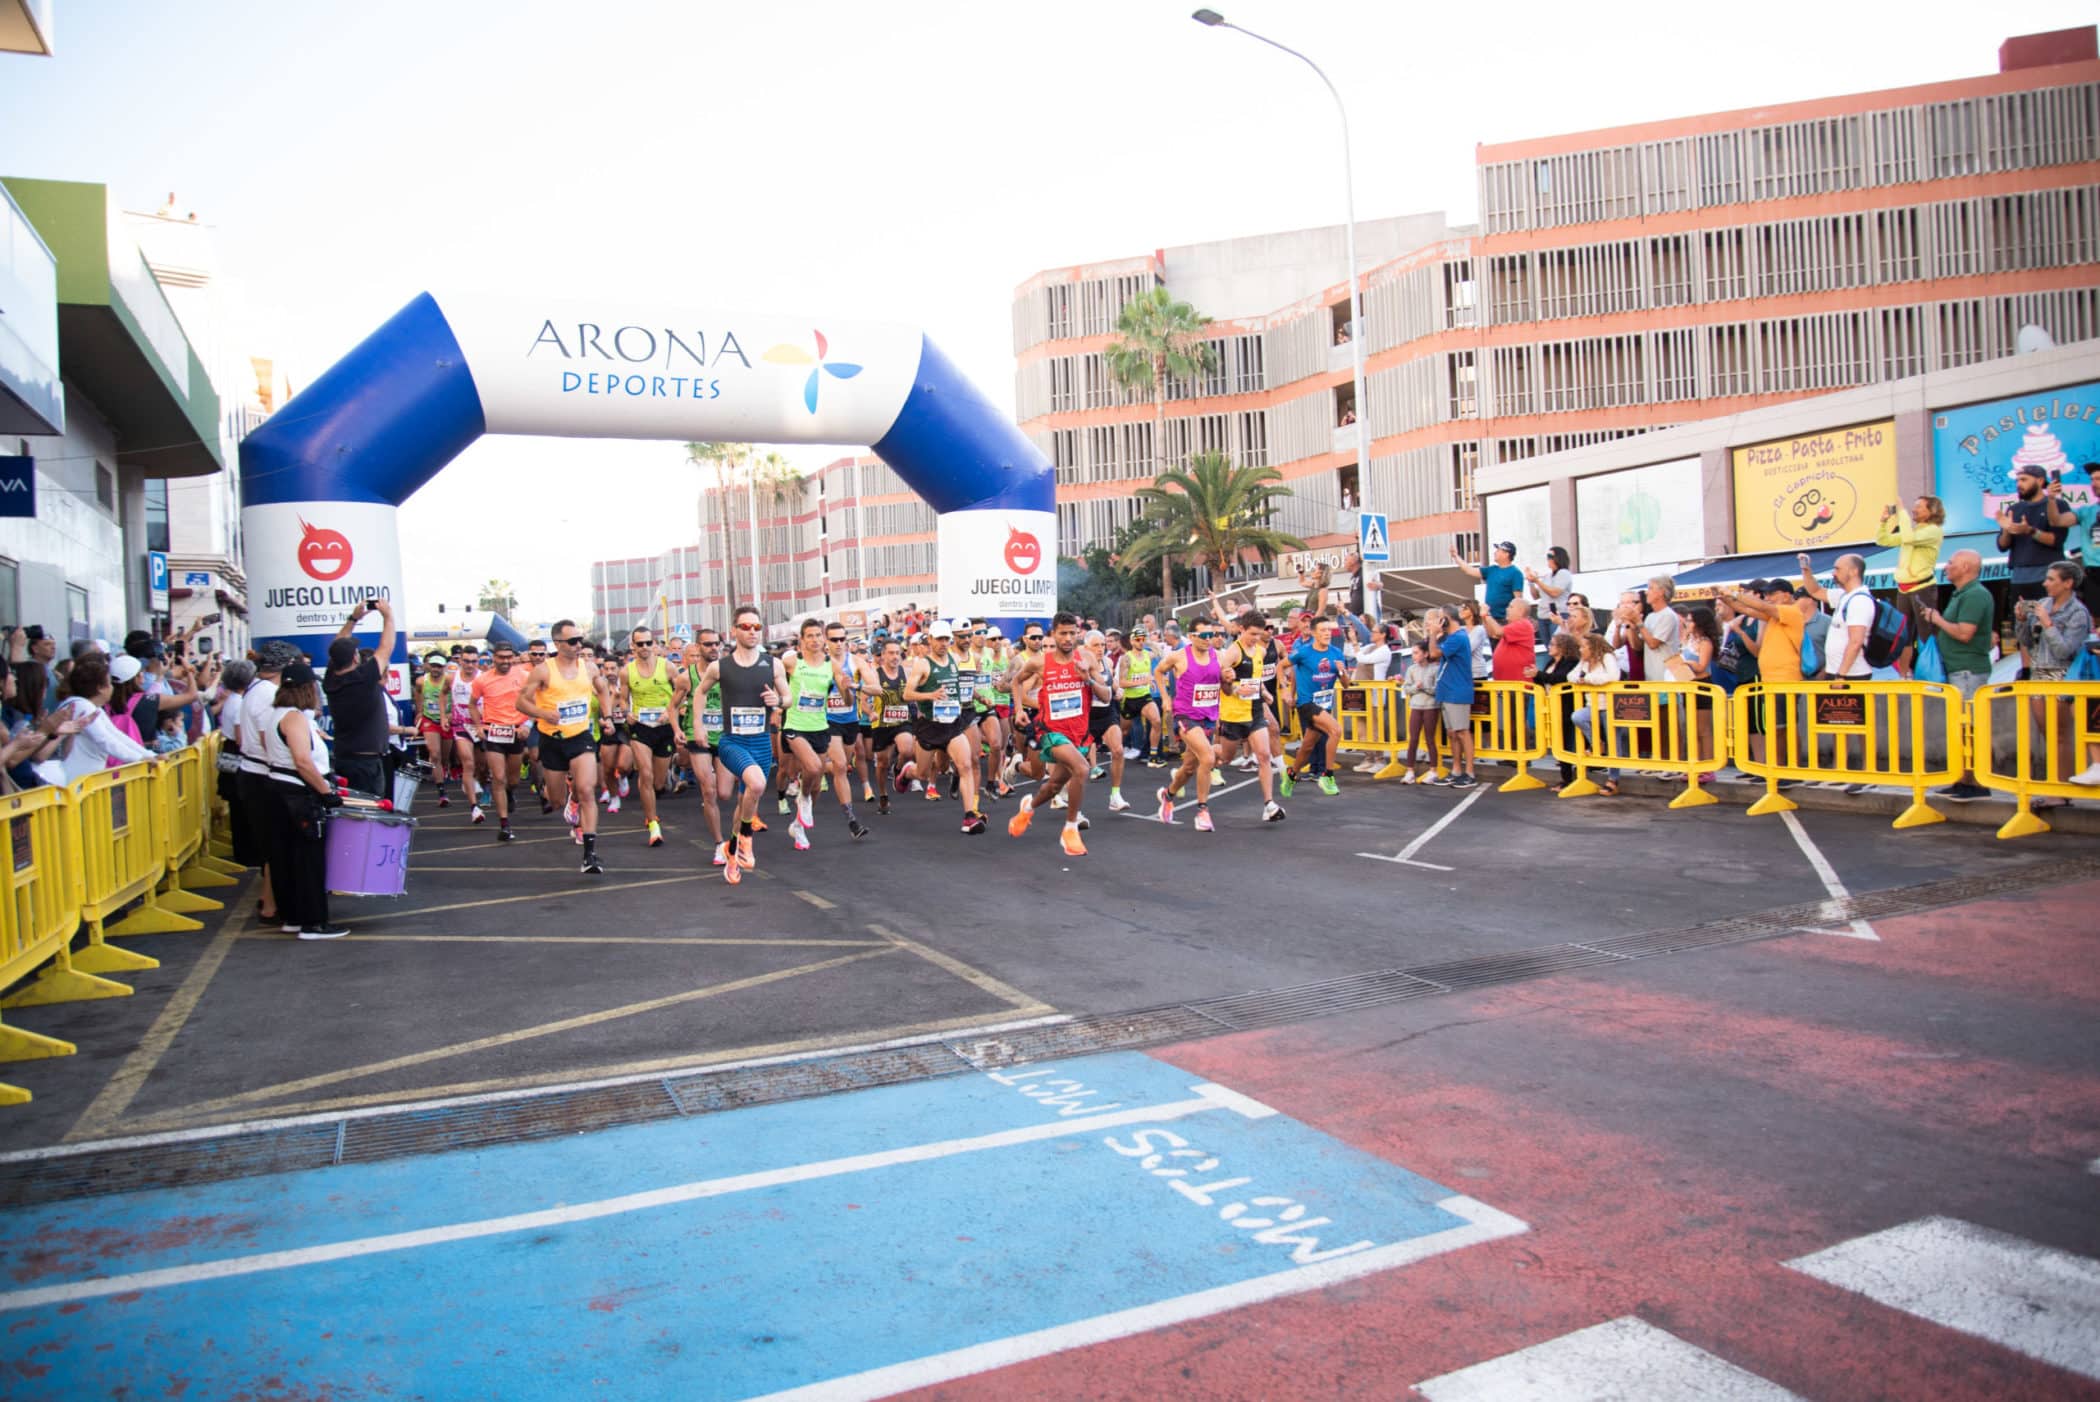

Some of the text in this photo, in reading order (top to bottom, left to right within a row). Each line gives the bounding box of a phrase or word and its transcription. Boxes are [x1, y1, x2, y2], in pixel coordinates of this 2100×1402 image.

[526, 319, 752, 370] ARONA
[562, 371, 721, 399] DEPORTES
[1747, 448, 1782, 467] Pizza
[1791, 434, 1834, 460] Pasta
[153, 556, 164, 587] P
[264, 586, 325, 609] JUEGO
[970, 578, 1021, 595] JUEGO
[296, 611, 328, 623] dentro
[330, 613, 336, 624] y
[706, 715, 719, 723] 10
[737, 715, 760, 724] 152
[1103, 1128, 1376, 1265] MOTOS
